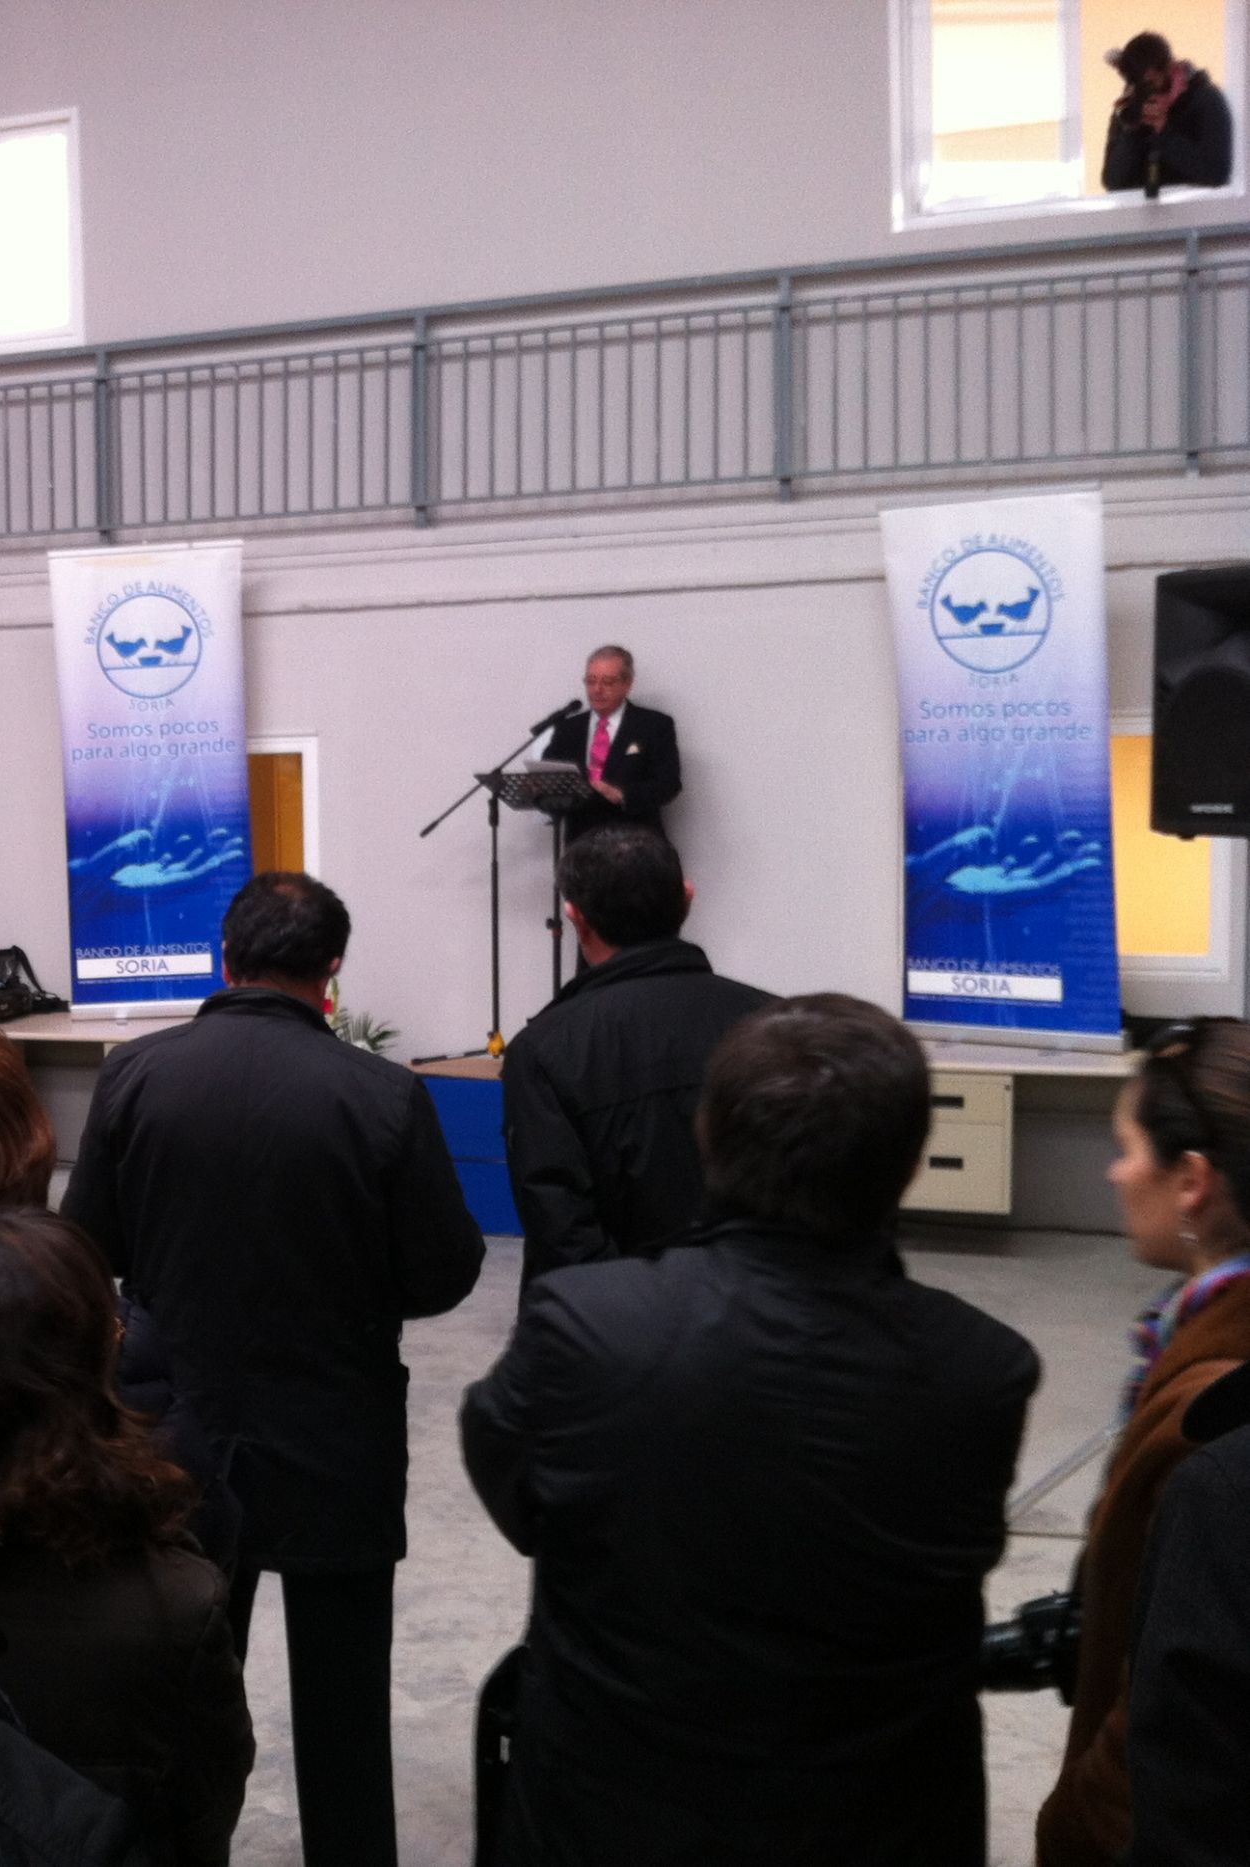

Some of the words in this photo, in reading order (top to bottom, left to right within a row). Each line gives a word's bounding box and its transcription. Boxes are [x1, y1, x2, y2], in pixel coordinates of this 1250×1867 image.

[84, 593, 119, 645] BANCO
[122, 581, 143, 597] DE
[148, 580, 214, 639] ALIMENTOS
[128, 698, 175, 712] SORIA
[919, 700, 996, 720] Somos
[1002, 699, 1071, 721] pocos
[87, 722, 153, 739] Somos
[159, 719, 219, 739] pocos
[904, 726, 950, 744] para
[957, 723, 1005, 747] algo
[1011, 722, 1092, 746] grande
[71, 745, 113, 763] para
[119, 741, 161, 760] algo
[167, 737, 236, 760] grande
[76, 947, 122, 959] BANCO
[124, 945, 142, 957] DE
[144, 942, 211, 956] ALIMENTOS
[116, 959, 169, 974] SORIA
[907, 957, 958, 971] BANCO
[961, 959, 978, 972] DE
[951, 975, 1012, 995] SORIA
